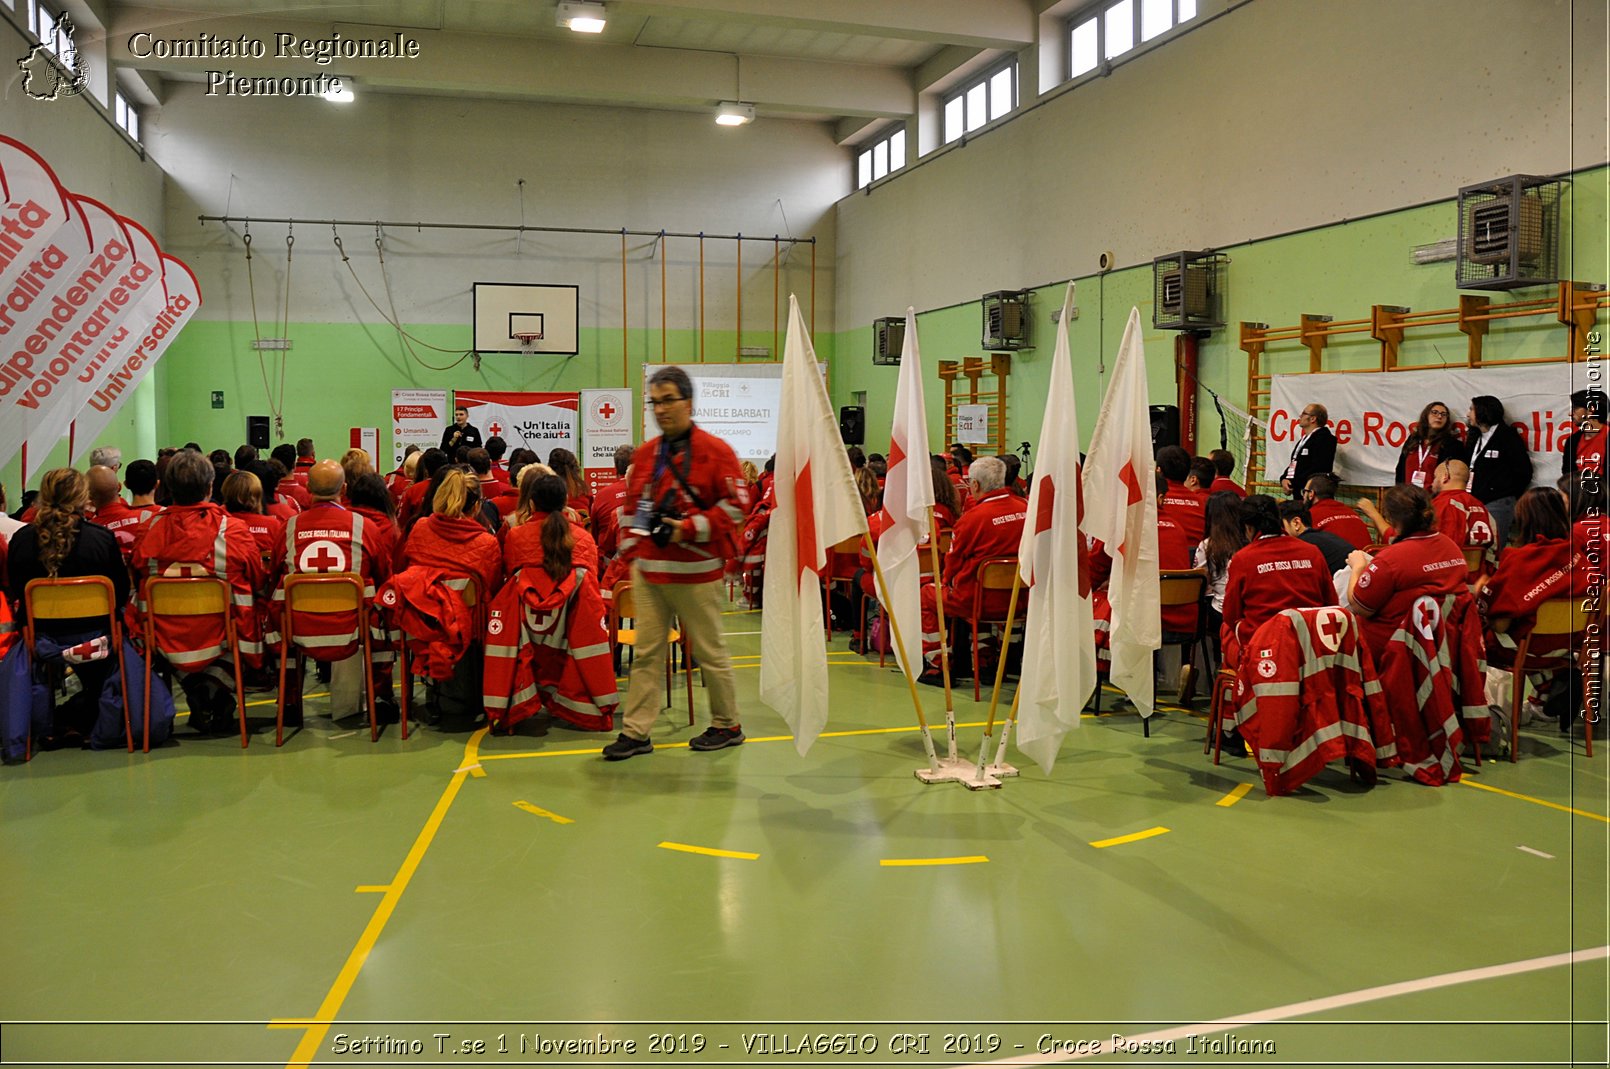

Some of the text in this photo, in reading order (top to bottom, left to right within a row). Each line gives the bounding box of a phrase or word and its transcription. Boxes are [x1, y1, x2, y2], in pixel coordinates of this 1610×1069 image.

[88, 293, 191, 412] Universalità
[712, 389, 730, 398] CRI
[731, 408, 771, 418] BARBATI
[523, 421, 570, 430] Un'Italia
[523, 430, 570, 439] che aiuta
[1317, 516, 1334, 527] CROCE
[298, 530, 350, 539] CROCE ROSSA ITALIANA
[1257, 559, 1312, 574] CROCE ROSSA ITALIANA
[1523, 582, 1547, 601] CROCE
[1545, 570, 1563, 586] ROSSA
